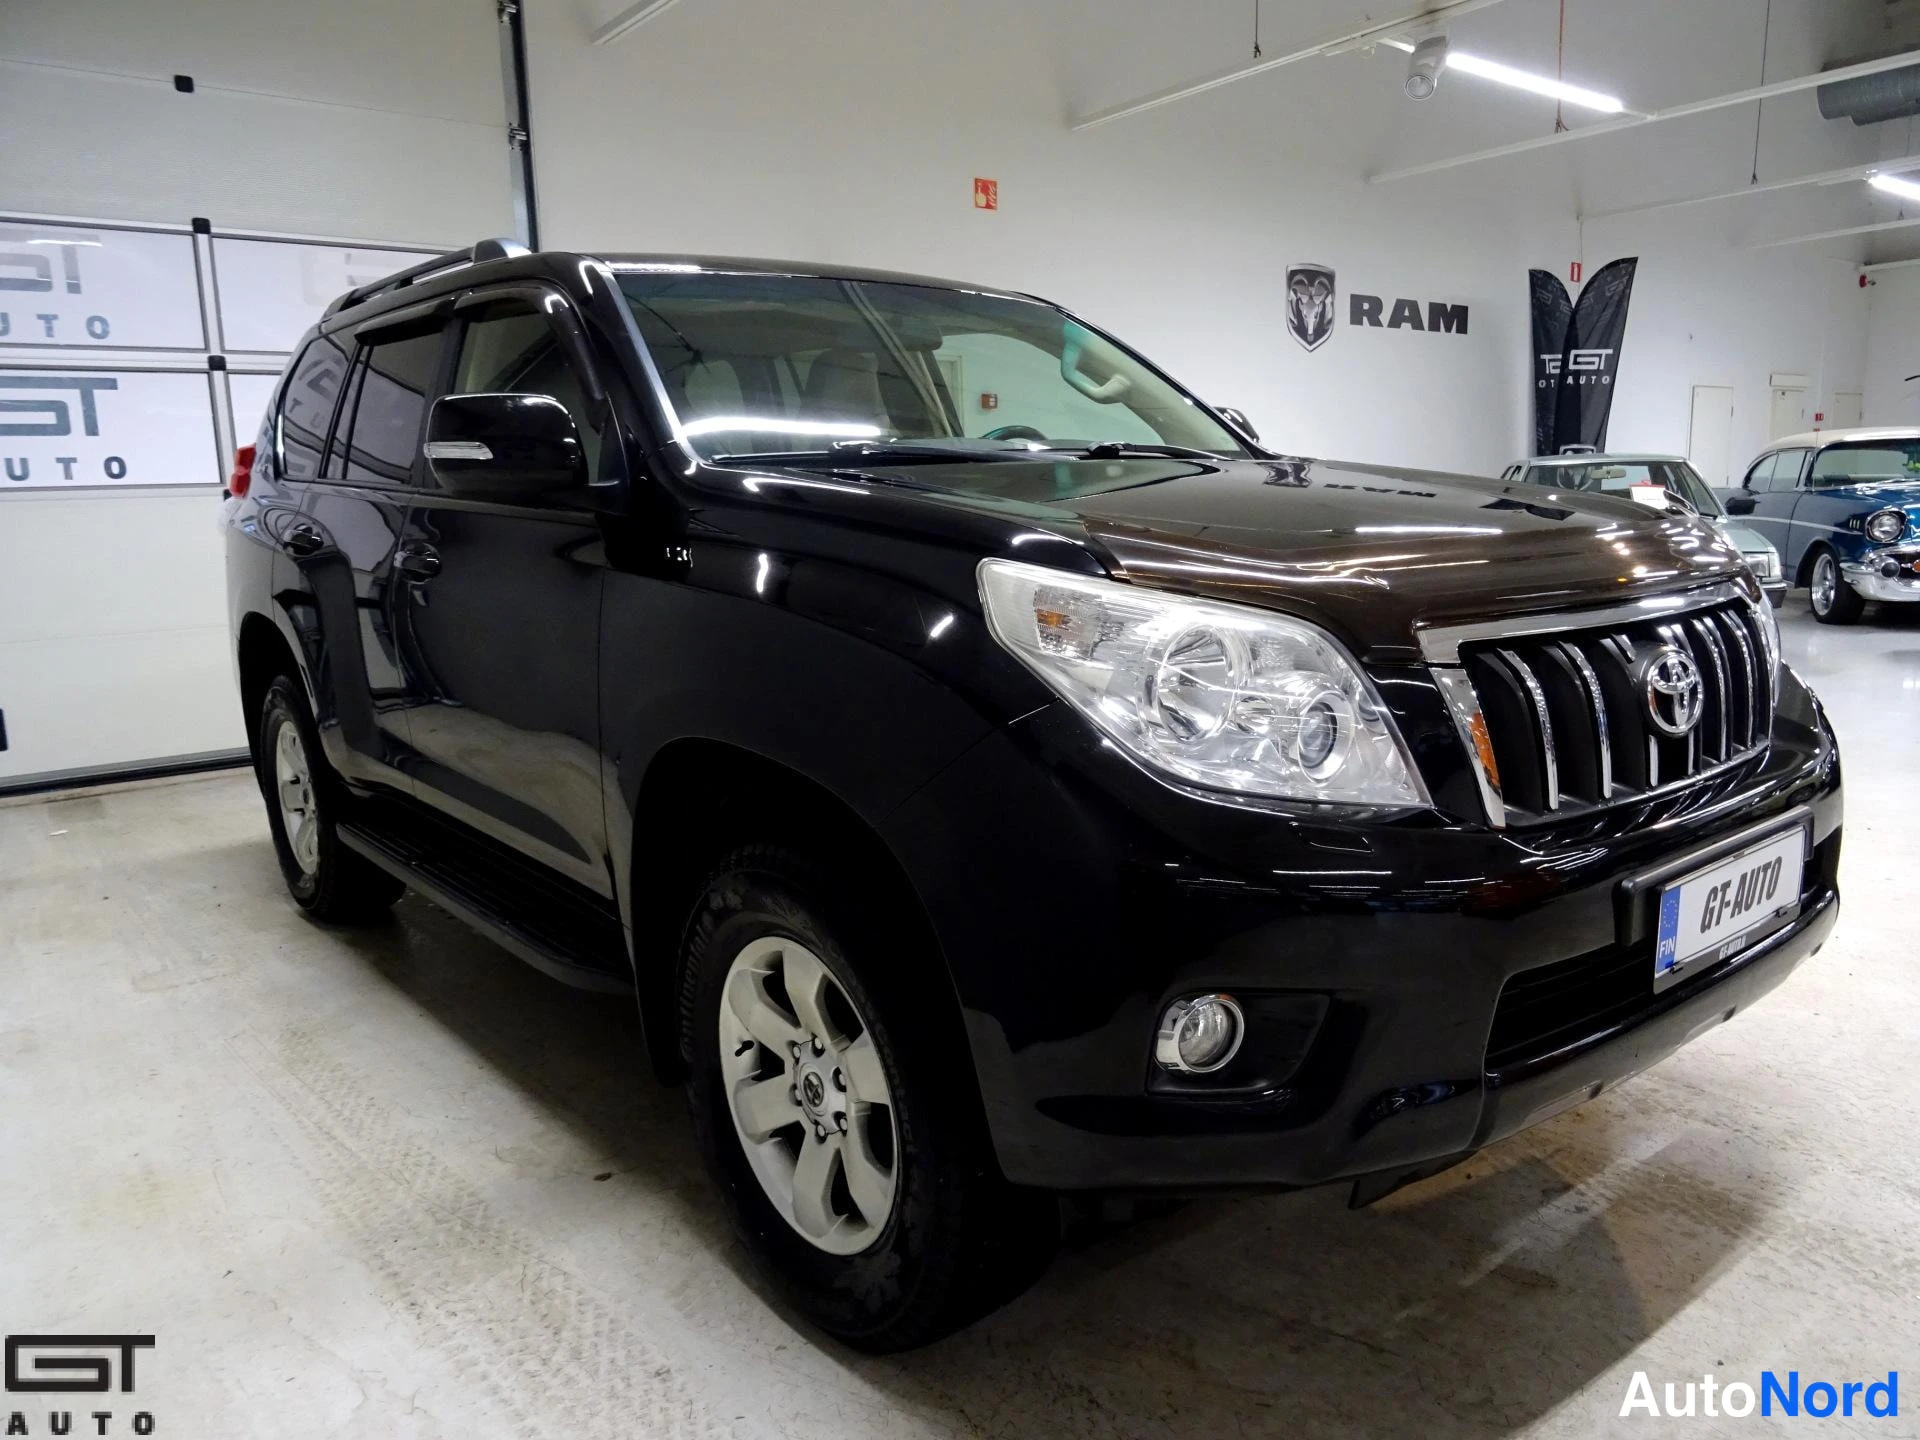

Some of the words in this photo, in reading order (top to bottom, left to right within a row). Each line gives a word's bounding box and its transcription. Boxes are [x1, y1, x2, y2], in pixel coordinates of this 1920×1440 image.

[1349, 293, 1469, 335] RAM
[1566, 375, 1610, 385] AUTO
[3, 456, 127, 481] UTO
[1699, 855, 1783, 934] GT-AUTO
[1659, 935, 1676, 959] FIN
